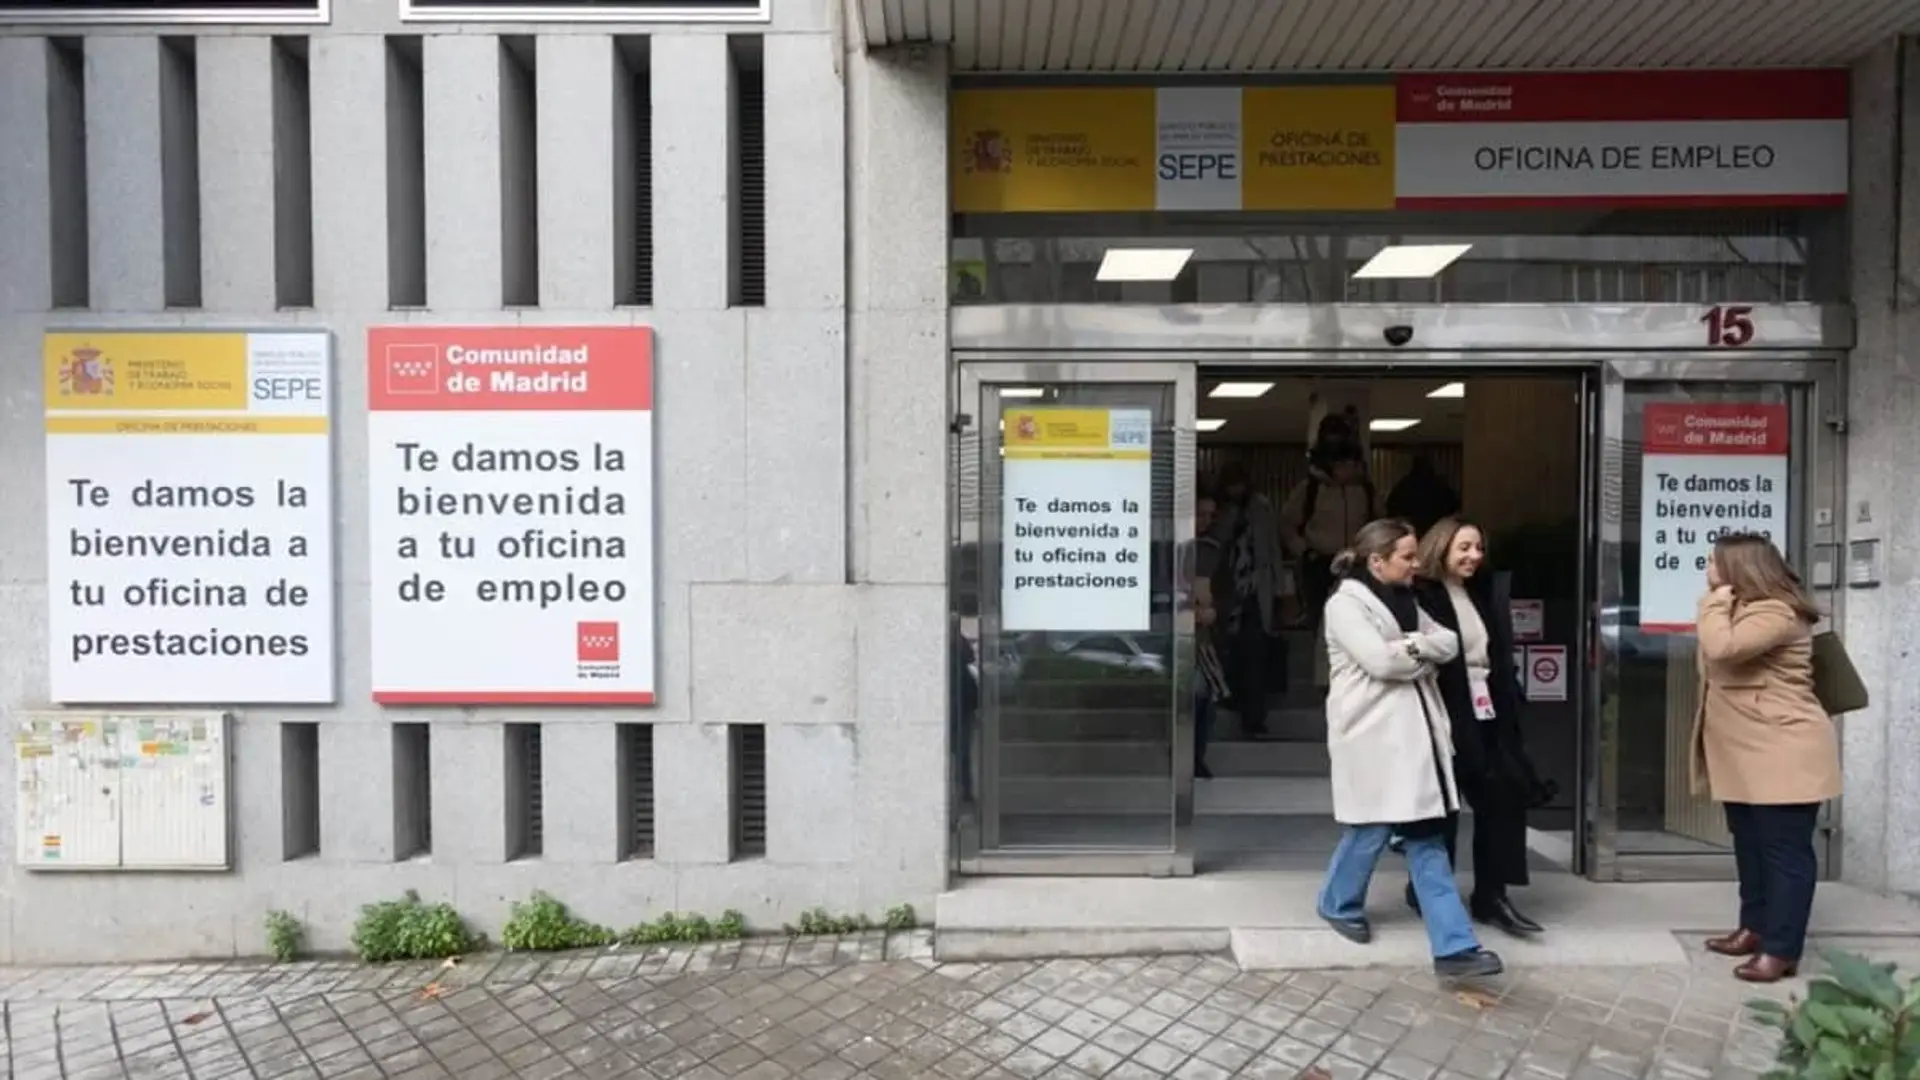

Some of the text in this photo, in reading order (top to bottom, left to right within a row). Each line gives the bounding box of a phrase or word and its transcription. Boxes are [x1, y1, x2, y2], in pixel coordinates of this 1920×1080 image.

[1436, 85, 1513, 97] Comunidad
[1436, 98, 1513, 111] de Madrid
[1271, 130, 1373, 147] OFICINA DE
[1259, 149, 1381, 166] PRESTACIONES
[1475, 144, 1775, 170] OFICINA DE EMPLEO
[1159, 154, 1236, 180] SEPE
[1701, 305, 1754, 346] 15
[446, 345, 588, 365] Comunidad
[253, 377, 322, 401] SEPE
[446, 371, 588, 393] de Madrid
[116, 422, 257, 432] OFICINA DE PRESTACIONES
[1684, 414, 1768, 428] Comunidad
[1113, 431, 1148, 443] SEPE
[1684, 431, 1767, 446] de Madrid
[396, 443, 625, 472] Te damos la
[1656, 473, 1773, 493] Te damos la
[69, 479, 307, 508] Te damos la
[398, 486, 625, 516] bienvenida
[1015, 498, 1139, 513] Te damos la
[1656, 500, 1773, 519] bienvenida
[1015, 523, 1139, 539] bienvenida a
[1656, 529, 1667, 544] a
[1677, 527, 1696, 545] tu
[71, 528, 308, 557] bienvenida a
[398, 528, 626, 559] a tu oficina
[1015, 547, 1139, 564] tu oficina de
[1656, 551, 1680, 570] de
[399, 572, 626, 610] de empleo
[1015, 573, 1139, 590] prestaciones
[71, 577, 309, 607] tu oficina de
[73, 627, 309, 663] prestaciones
